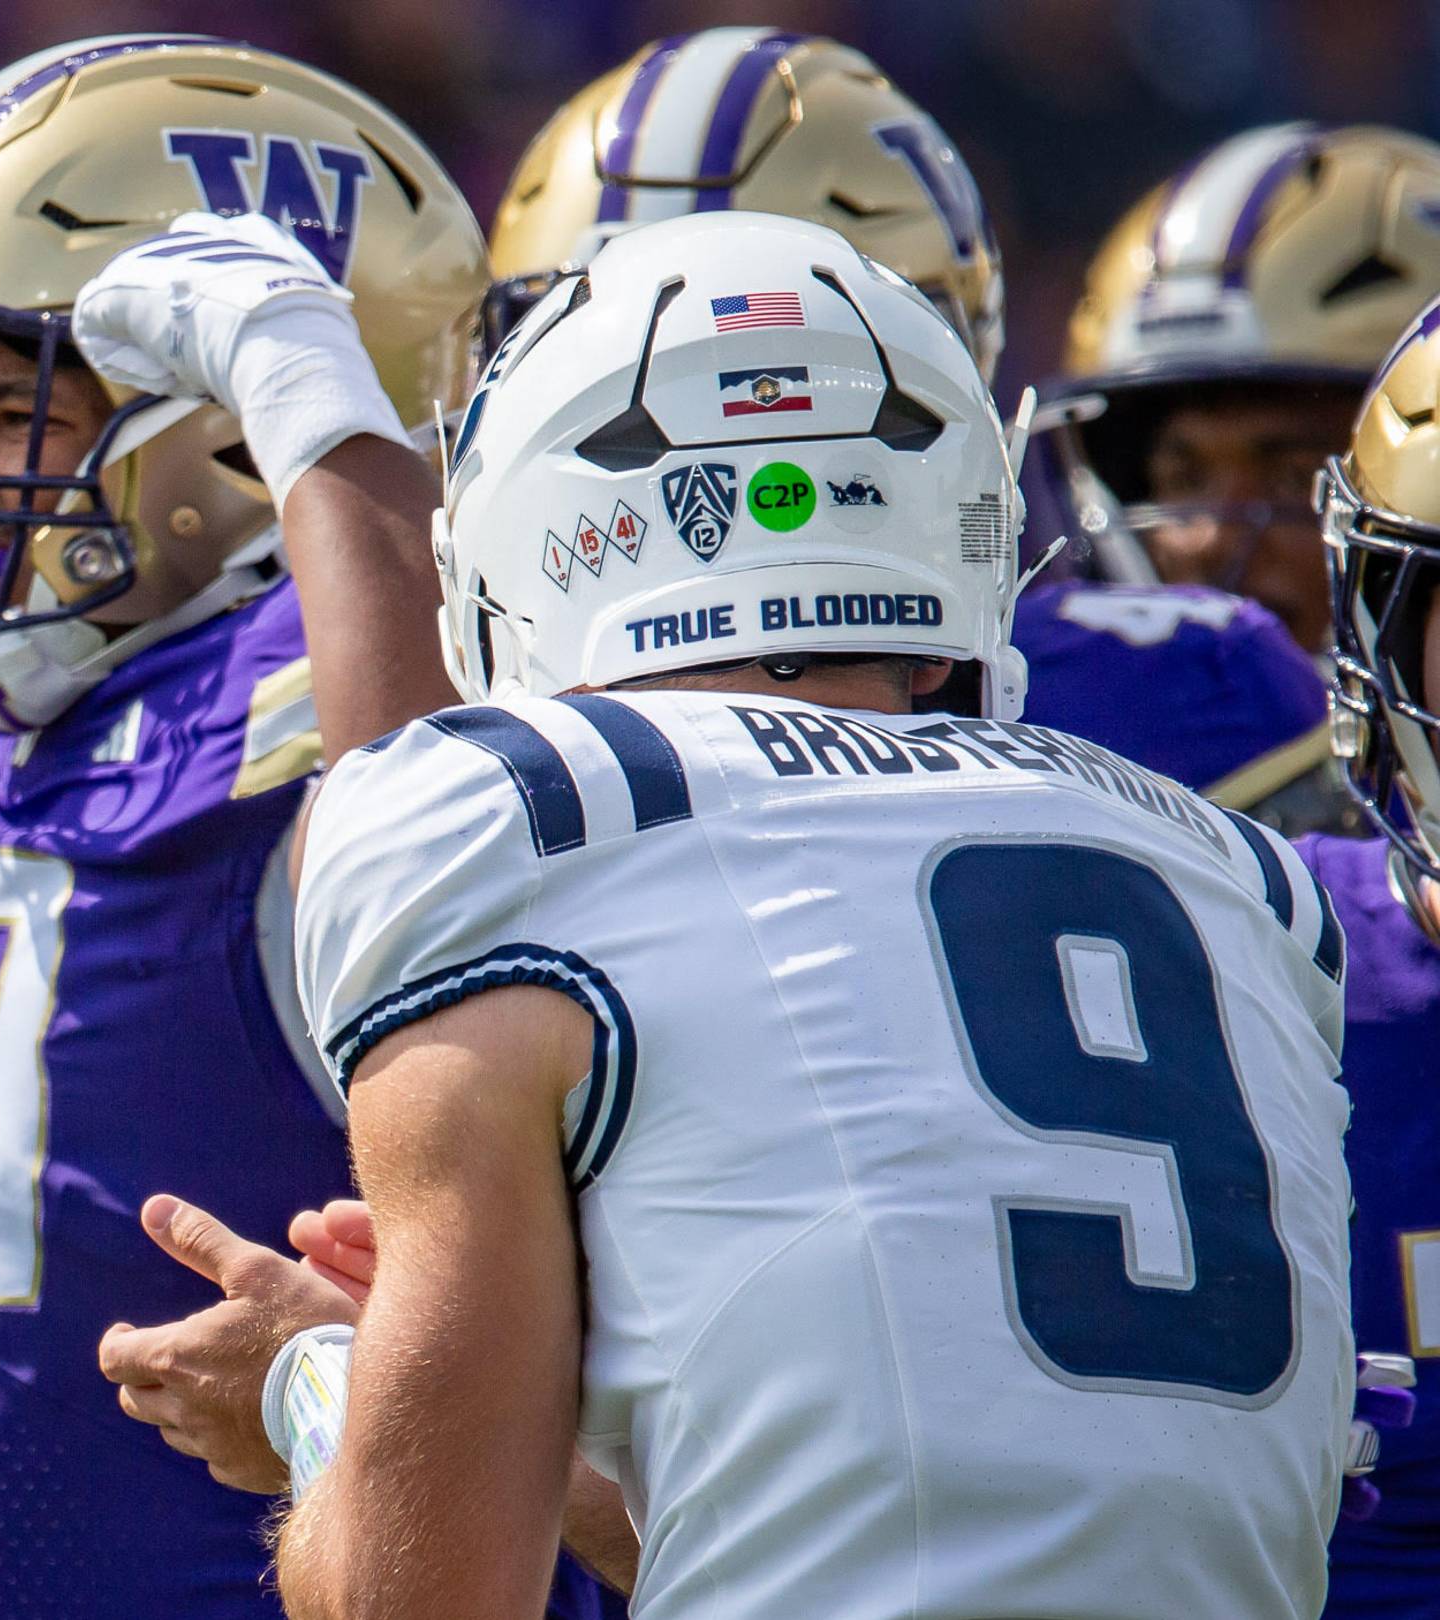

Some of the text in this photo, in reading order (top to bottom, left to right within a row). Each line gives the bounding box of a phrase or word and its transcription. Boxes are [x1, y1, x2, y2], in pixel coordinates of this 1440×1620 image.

[753, 482, 809, 509] C2P
[616, 514, 638, 539] 41
[694, 528, 716, 549] 12
[579, 528, 600, 555] 15
[626, 594, 943, 652] TRUE BLOODED
[917, 834, 1303, 1412] 9
